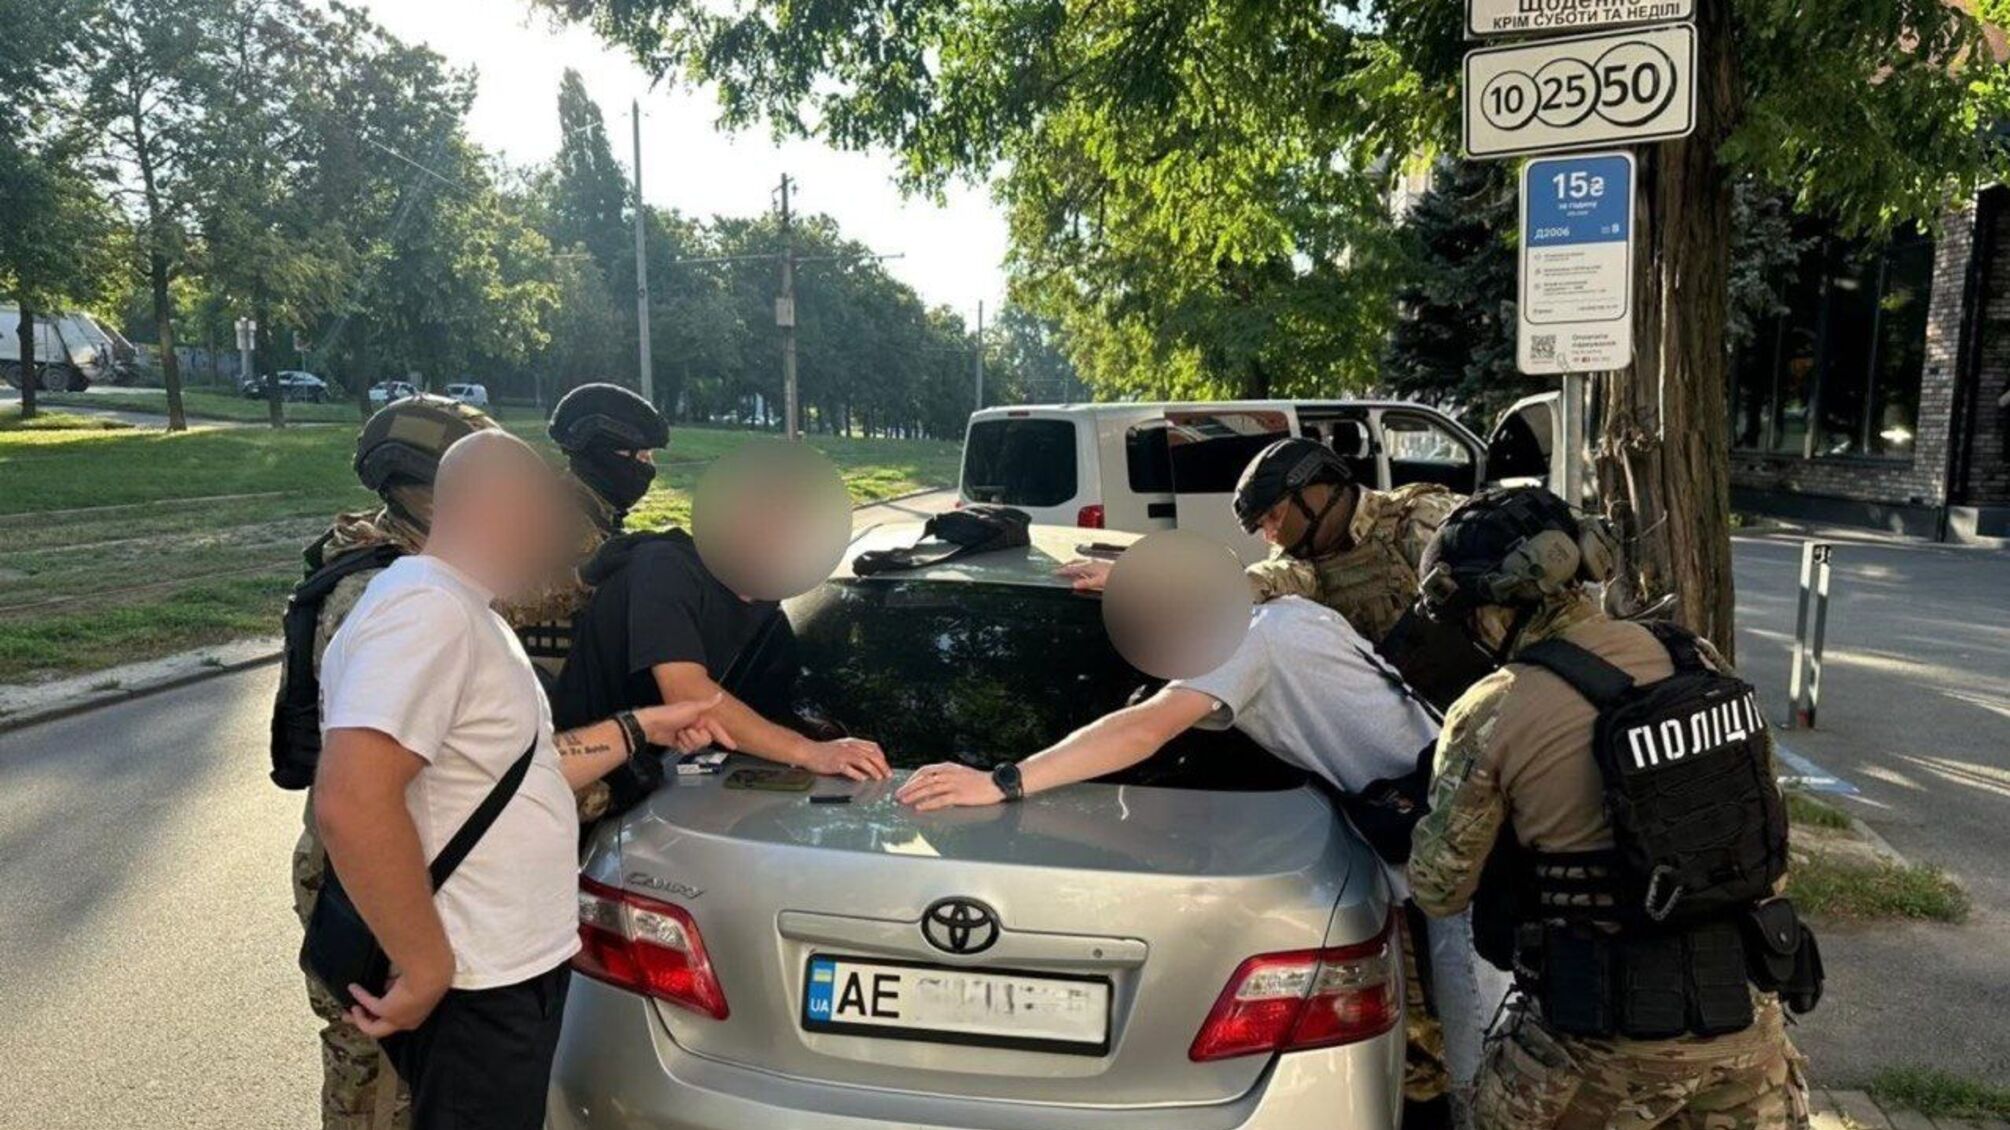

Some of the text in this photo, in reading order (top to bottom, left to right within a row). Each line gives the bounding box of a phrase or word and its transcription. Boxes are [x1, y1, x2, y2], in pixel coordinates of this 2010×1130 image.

[1493, 3, 1681, 30] КРІМ СУБОТИ ТА НЕДІЛІ
[1490, 62, 1661, 116] 10 25 50
[1534, 226, 1570, 240] Д2006
[810, 999, 830, 1013] UA
